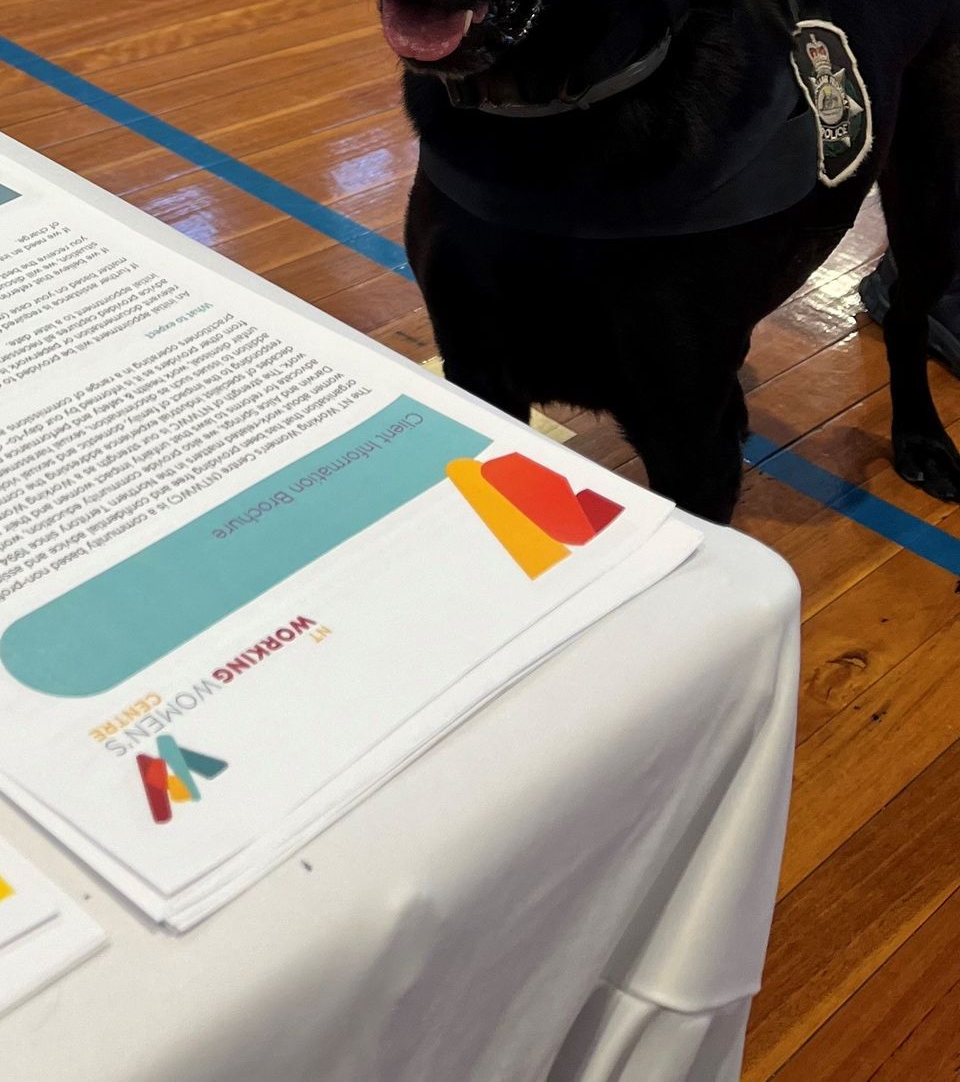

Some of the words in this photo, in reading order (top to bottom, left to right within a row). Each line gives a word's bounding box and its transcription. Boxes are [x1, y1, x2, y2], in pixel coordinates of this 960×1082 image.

[186, 302, 212, 317] What
[145, 322, 175, 338] expect
[338, 398, 353, 408] NT
[350, 387, 371, 398] The
[296, 407, 339, 430] Working
[376, 410, 430, 442] Client
[254, 430, 300, 454] Women's
[221, 453, 255, 472] Centre
[289, 441, 381, 492] Information
[167, 472, 222, 504] (NTWWC)
[212, 491, 293, 538] Brochure
[86, 514, 147, 548] community
[50, 547, 88, 570] based
[310, 626, 332, 644] NT
[212, 616, 316, 684] WORKING
[89, 692, 162, 742] CENTRE
[105, 678, 222, 756] WOMEN'S
